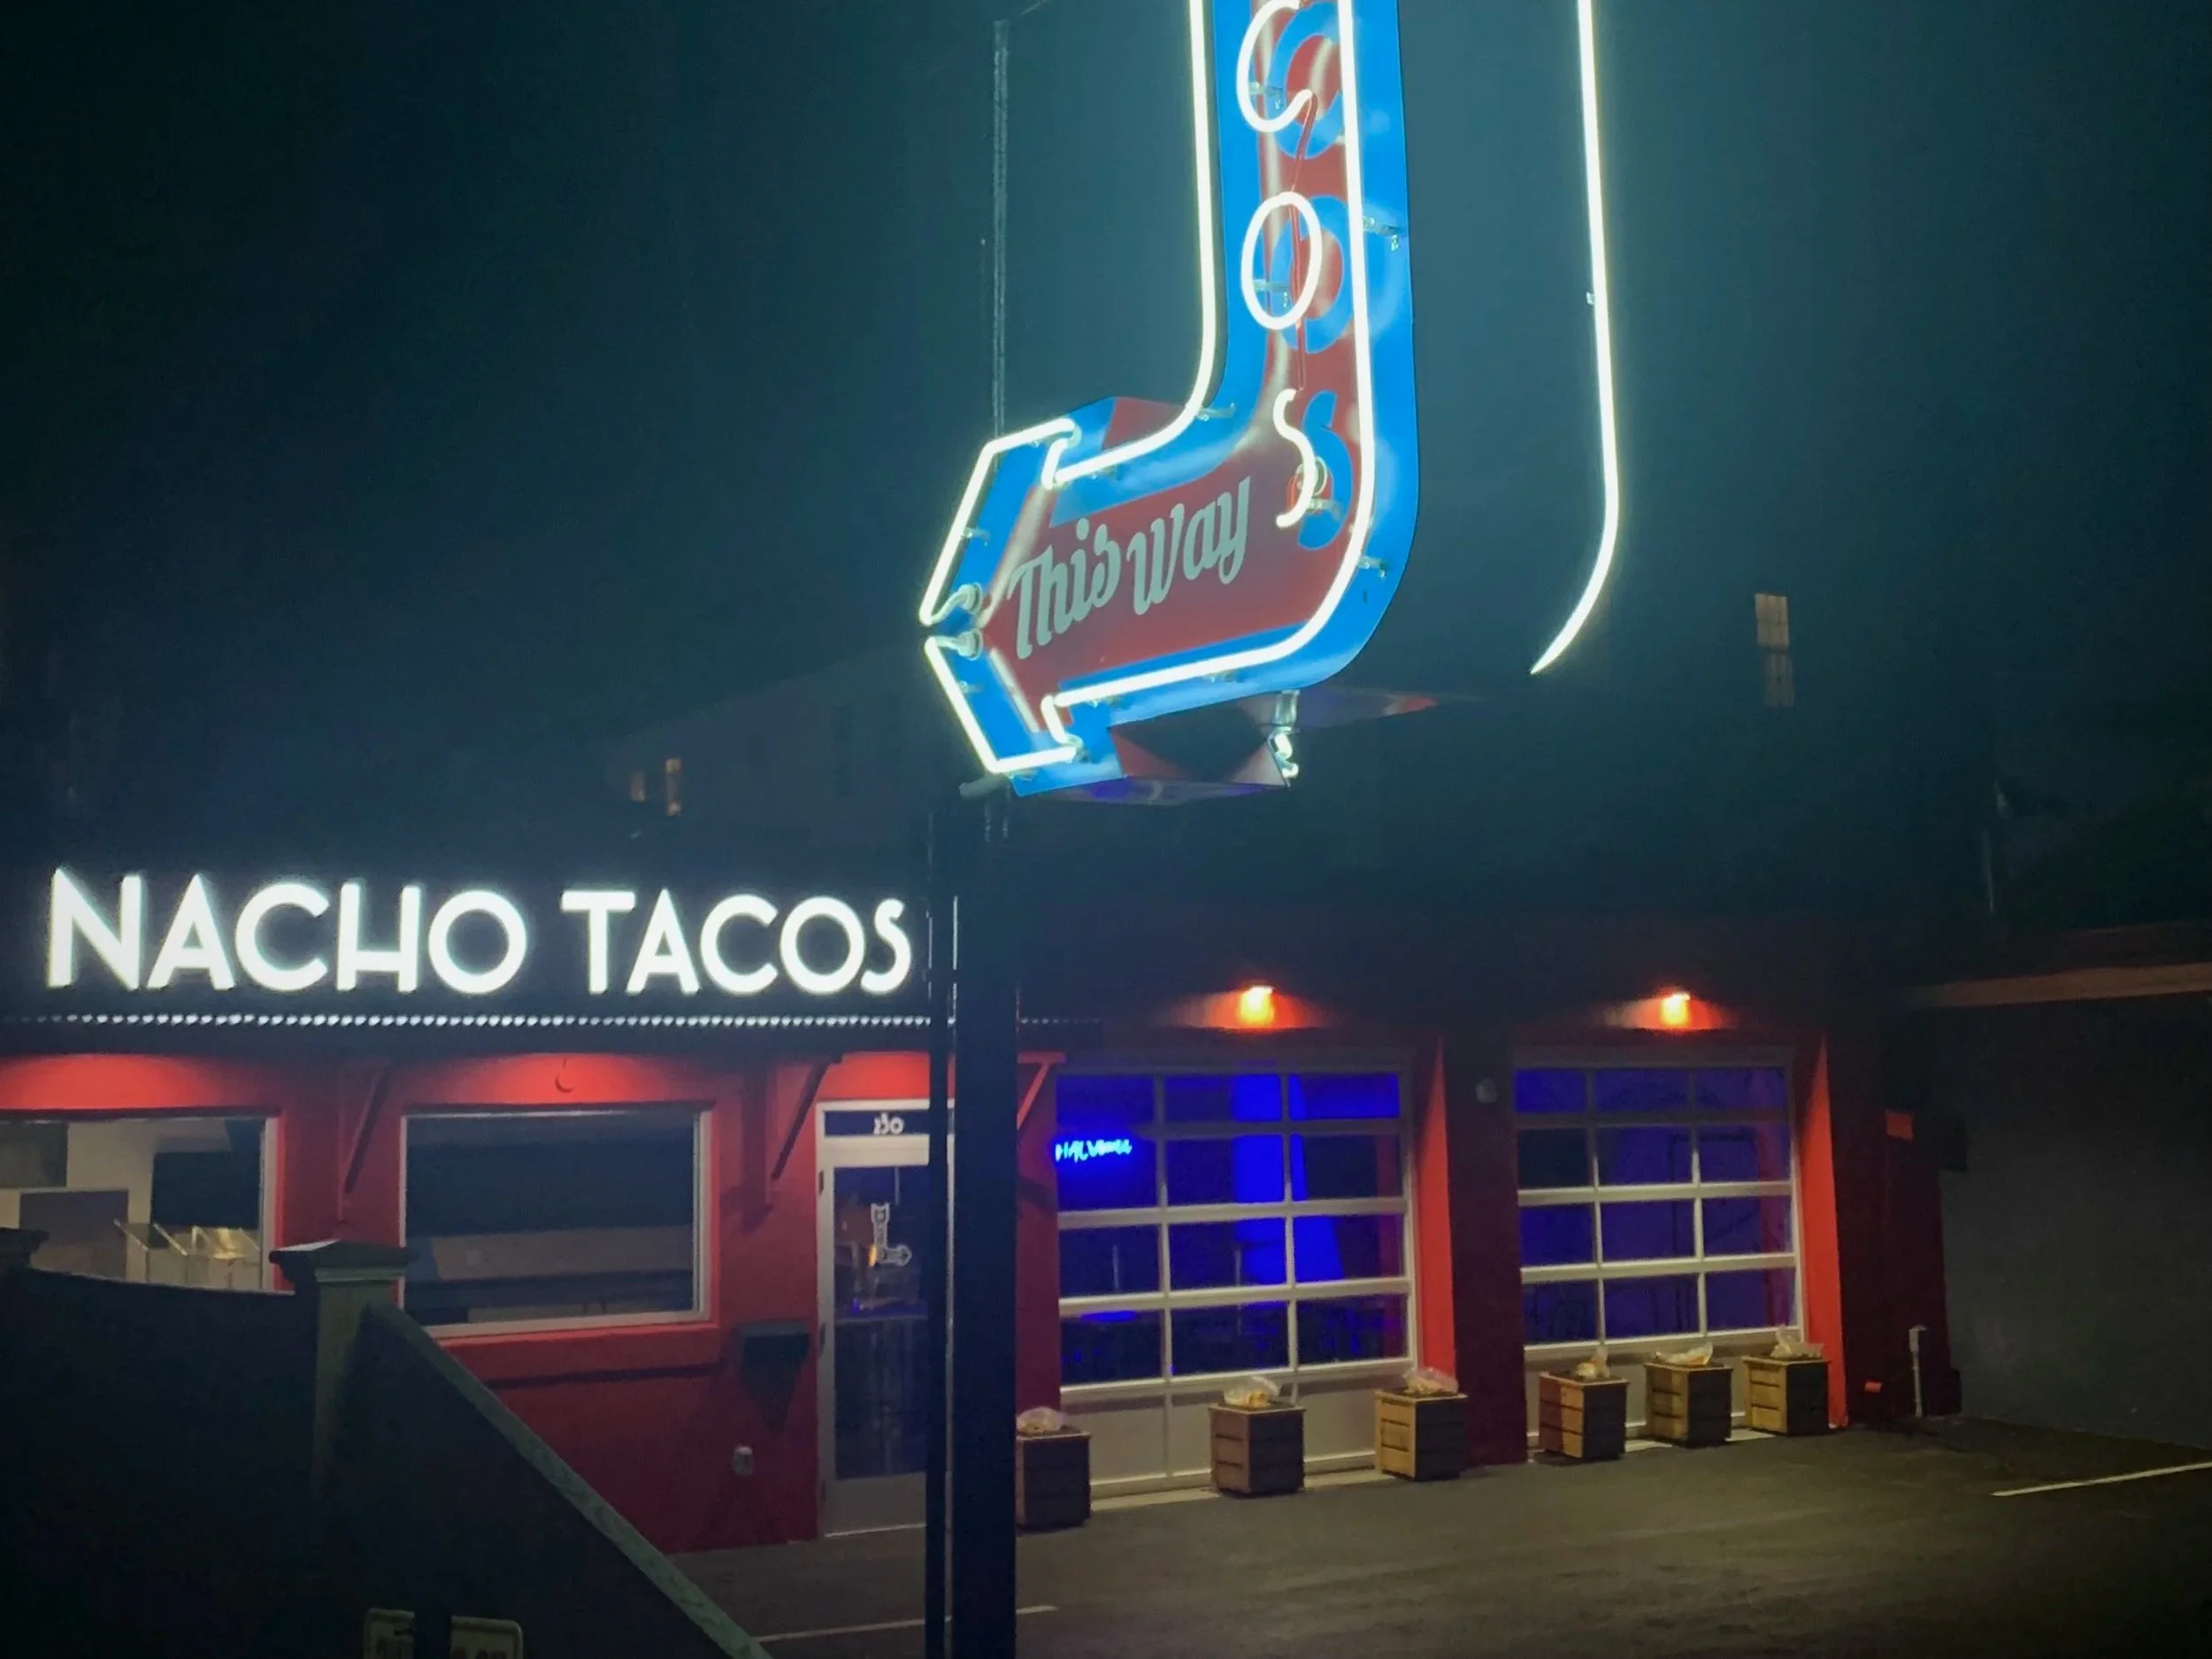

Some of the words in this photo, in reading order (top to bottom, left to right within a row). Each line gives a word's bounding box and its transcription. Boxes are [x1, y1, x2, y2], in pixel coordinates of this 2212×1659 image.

[1006, 518, 1121, 660] This
[1126, 476, 1250, 615] Way
[48, 867, 527, 995] NACHO
[560, 887, 911, 995] TACOS
